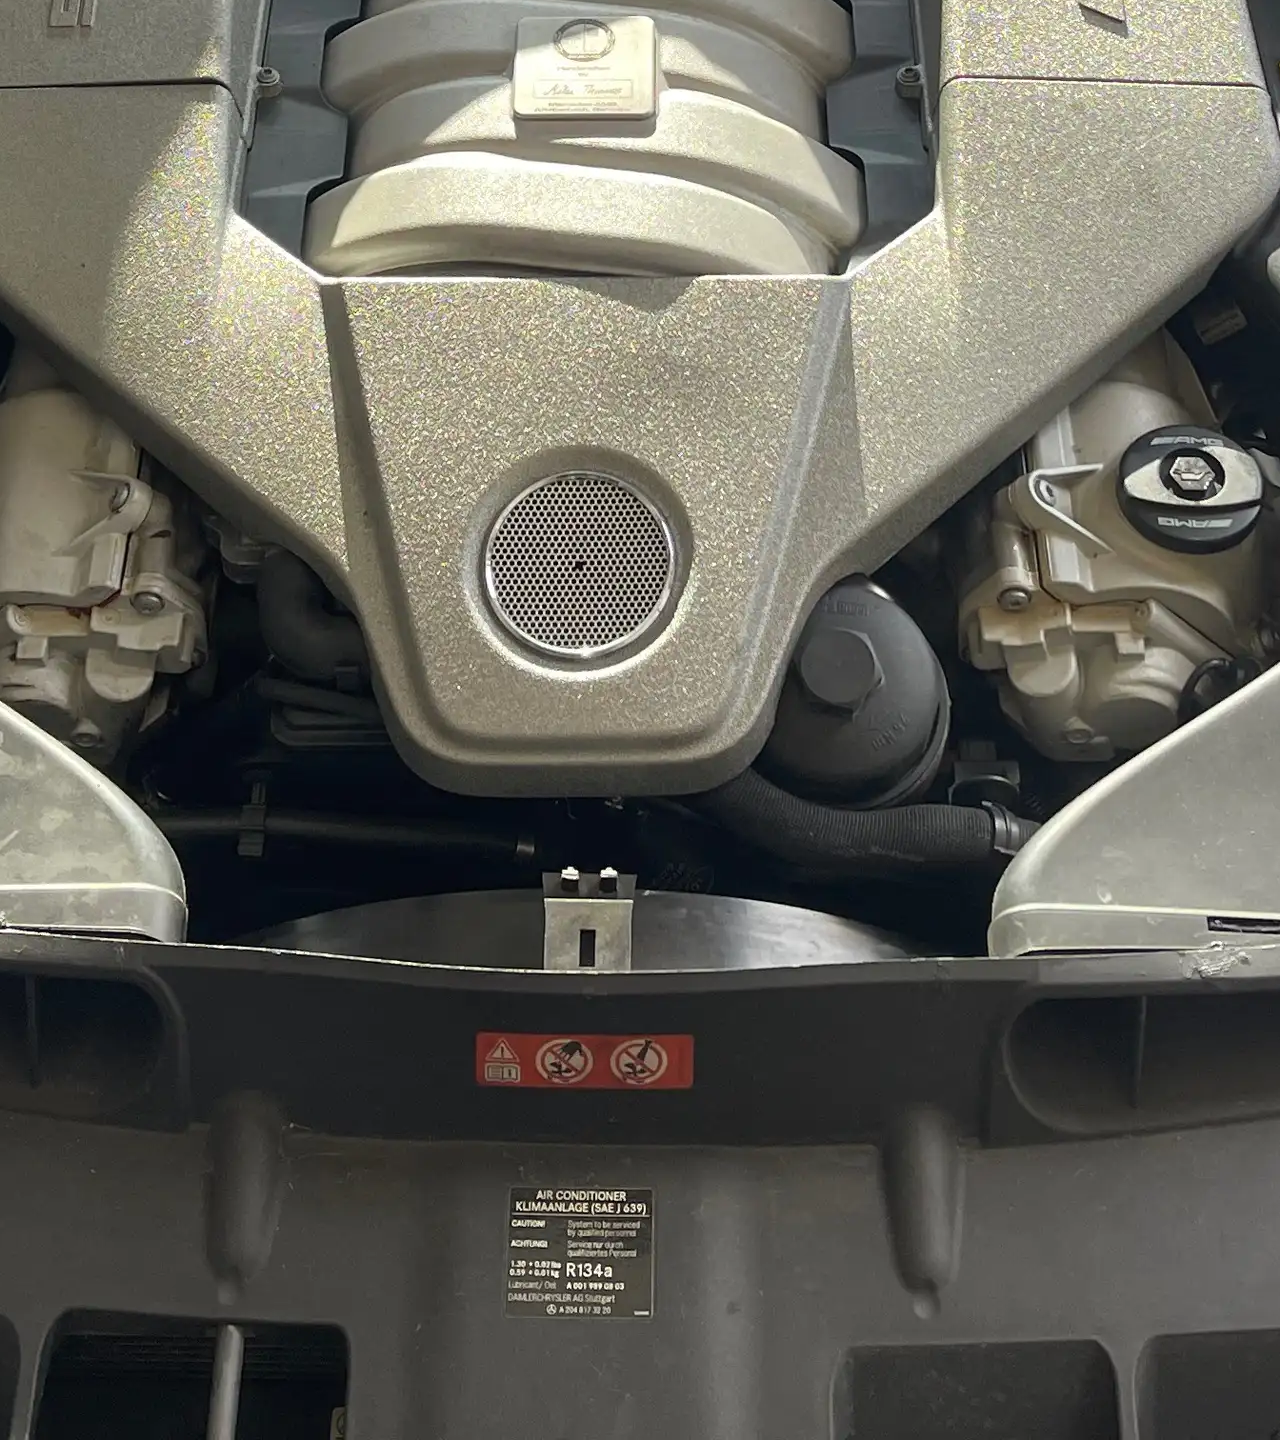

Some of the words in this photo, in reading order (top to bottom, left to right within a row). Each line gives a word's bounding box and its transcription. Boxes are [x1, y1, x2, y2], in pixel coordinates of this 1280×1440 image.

[536, 1190, 553, 1200] AIR
[556, 1191, 627, 1201] CONDITIONER
[516, 1202, 589, 1213] KLIMAANLAGE
[591, 1203, 614, 1215] (SAE
[616, 1204, 621, 1214] J
[623, 1203, 646, 1215] 639)
[567, 1220, 593, 1229] System
[603, 1221, 611, 1229] be
[612, 1221, 640, 1229] serviced
[567, 1229, 576, 1237] by
[551, 1270, 560, 1278] kg
[566, 1263, 613, 1278] R134a
[573, 1294, 584, 1302] AG
[585, 1294, 615, 1304] Stuttgart
